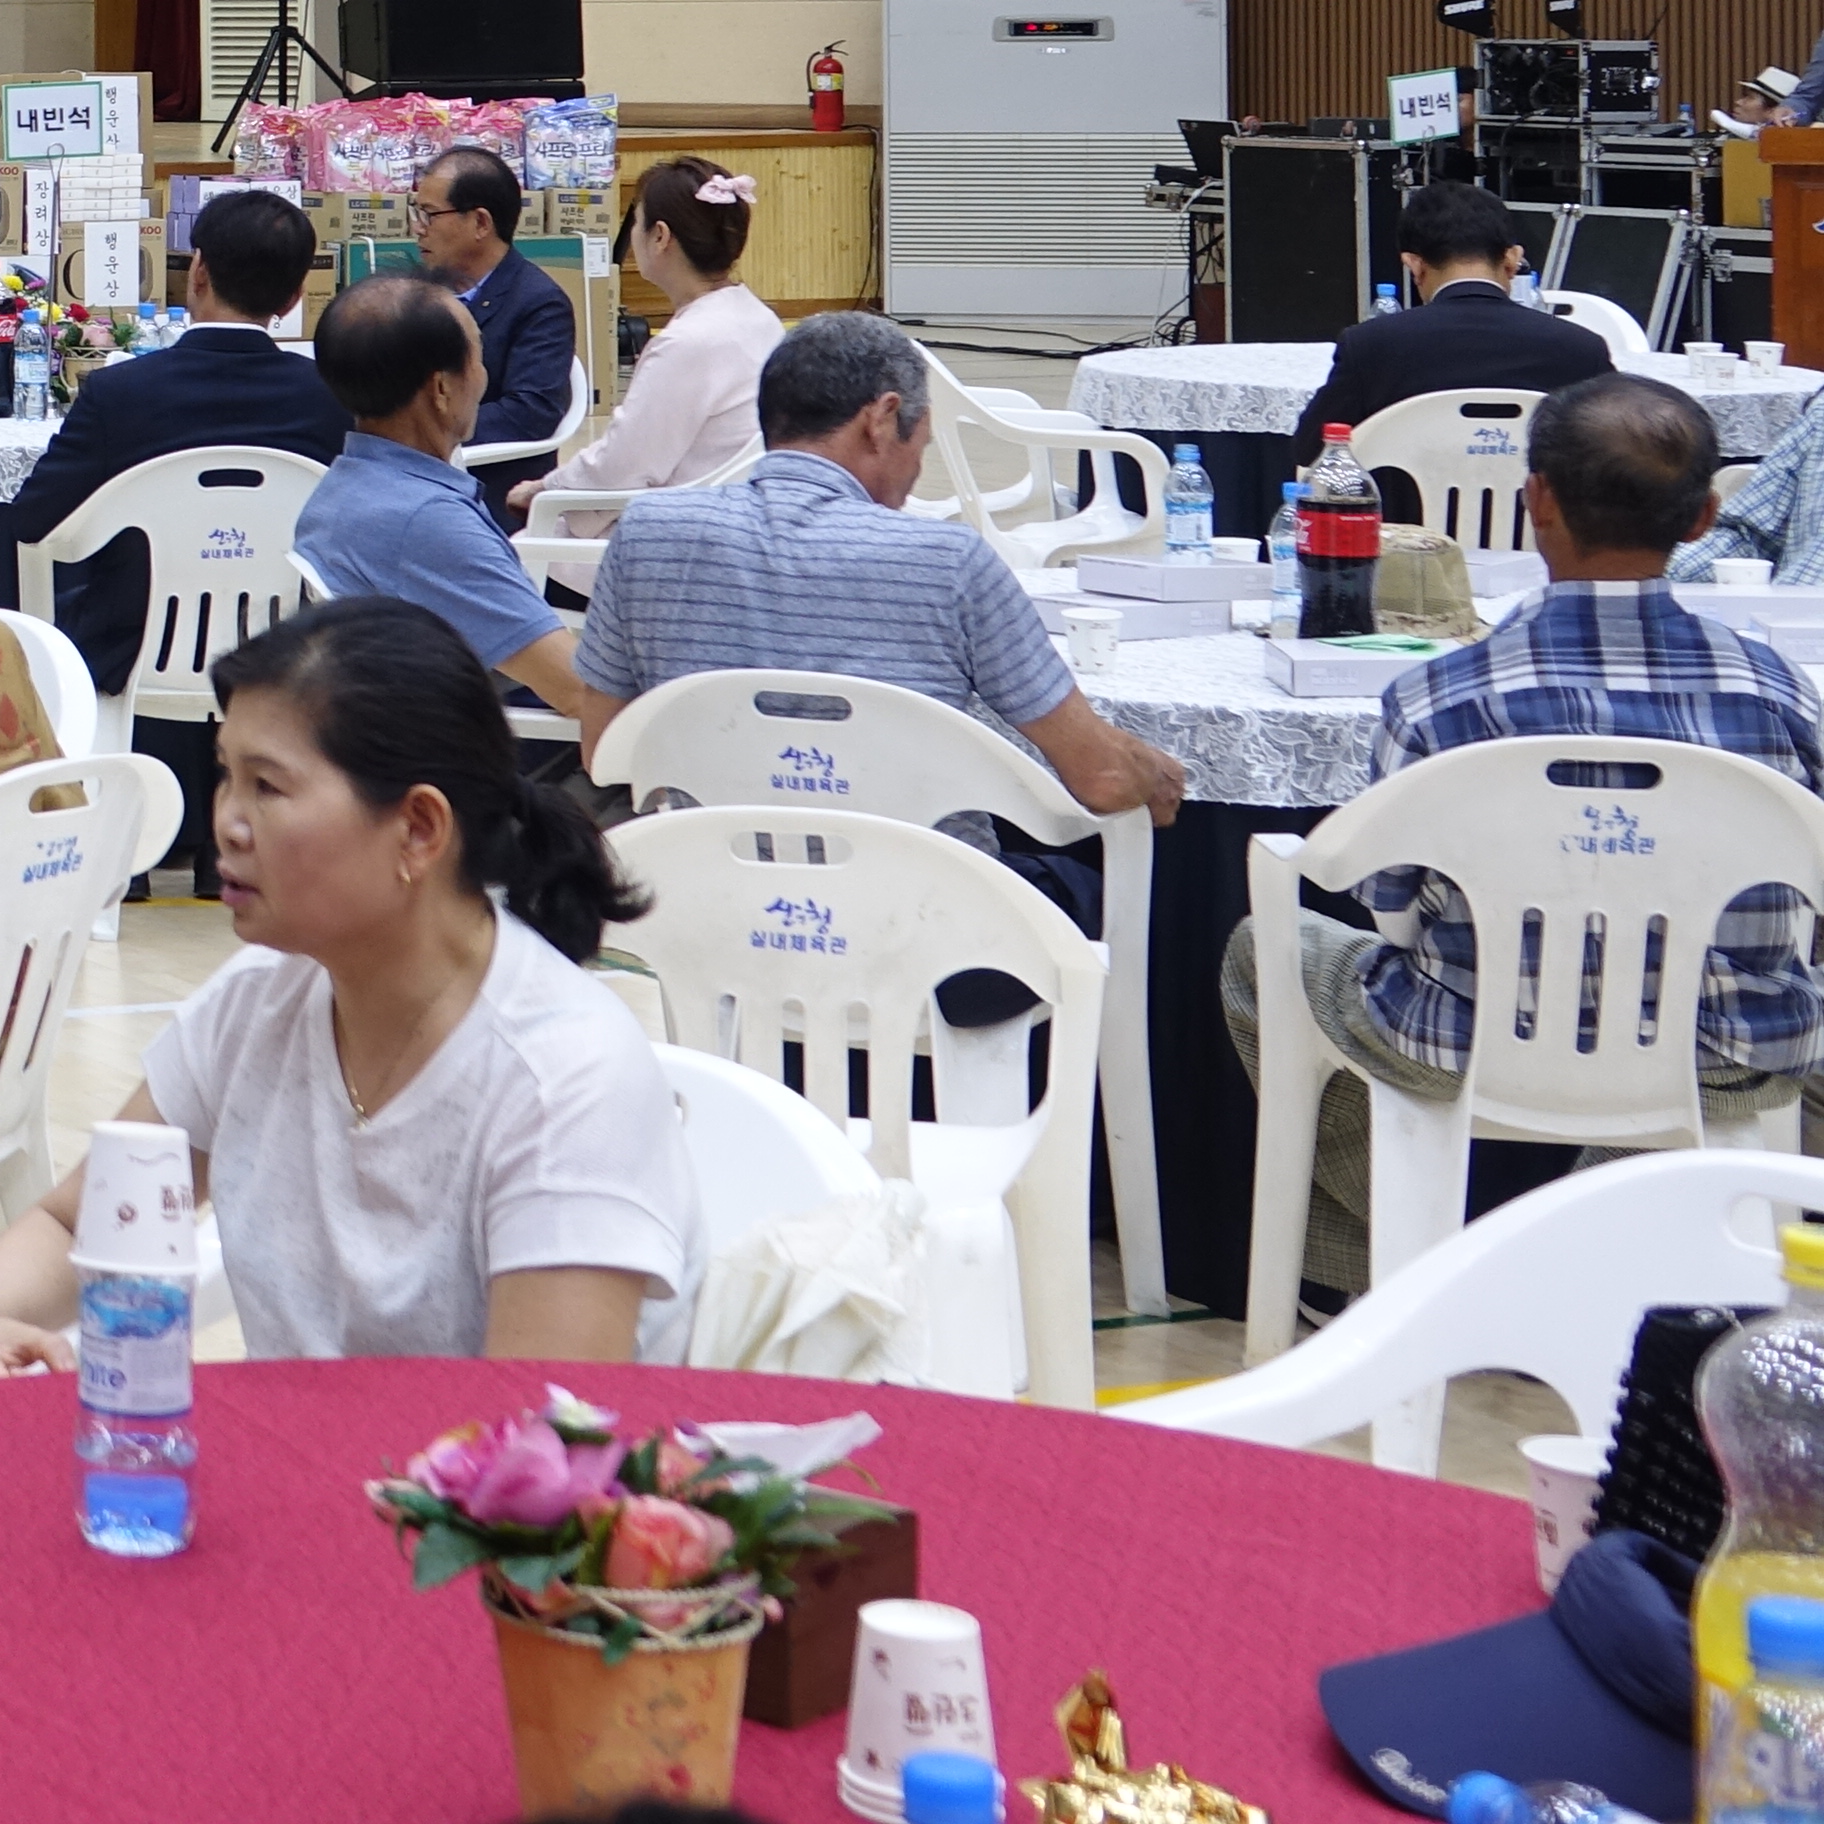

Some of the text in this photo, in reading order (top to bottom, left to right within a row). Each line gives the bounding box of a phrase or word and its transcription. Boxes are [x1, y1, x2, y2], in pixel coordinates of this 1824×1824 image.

[16, 106, 91, 133] 내빈석
[1399, 91, 1451, 123] 내빈석
[104, 232, 119, 297] 행운상
